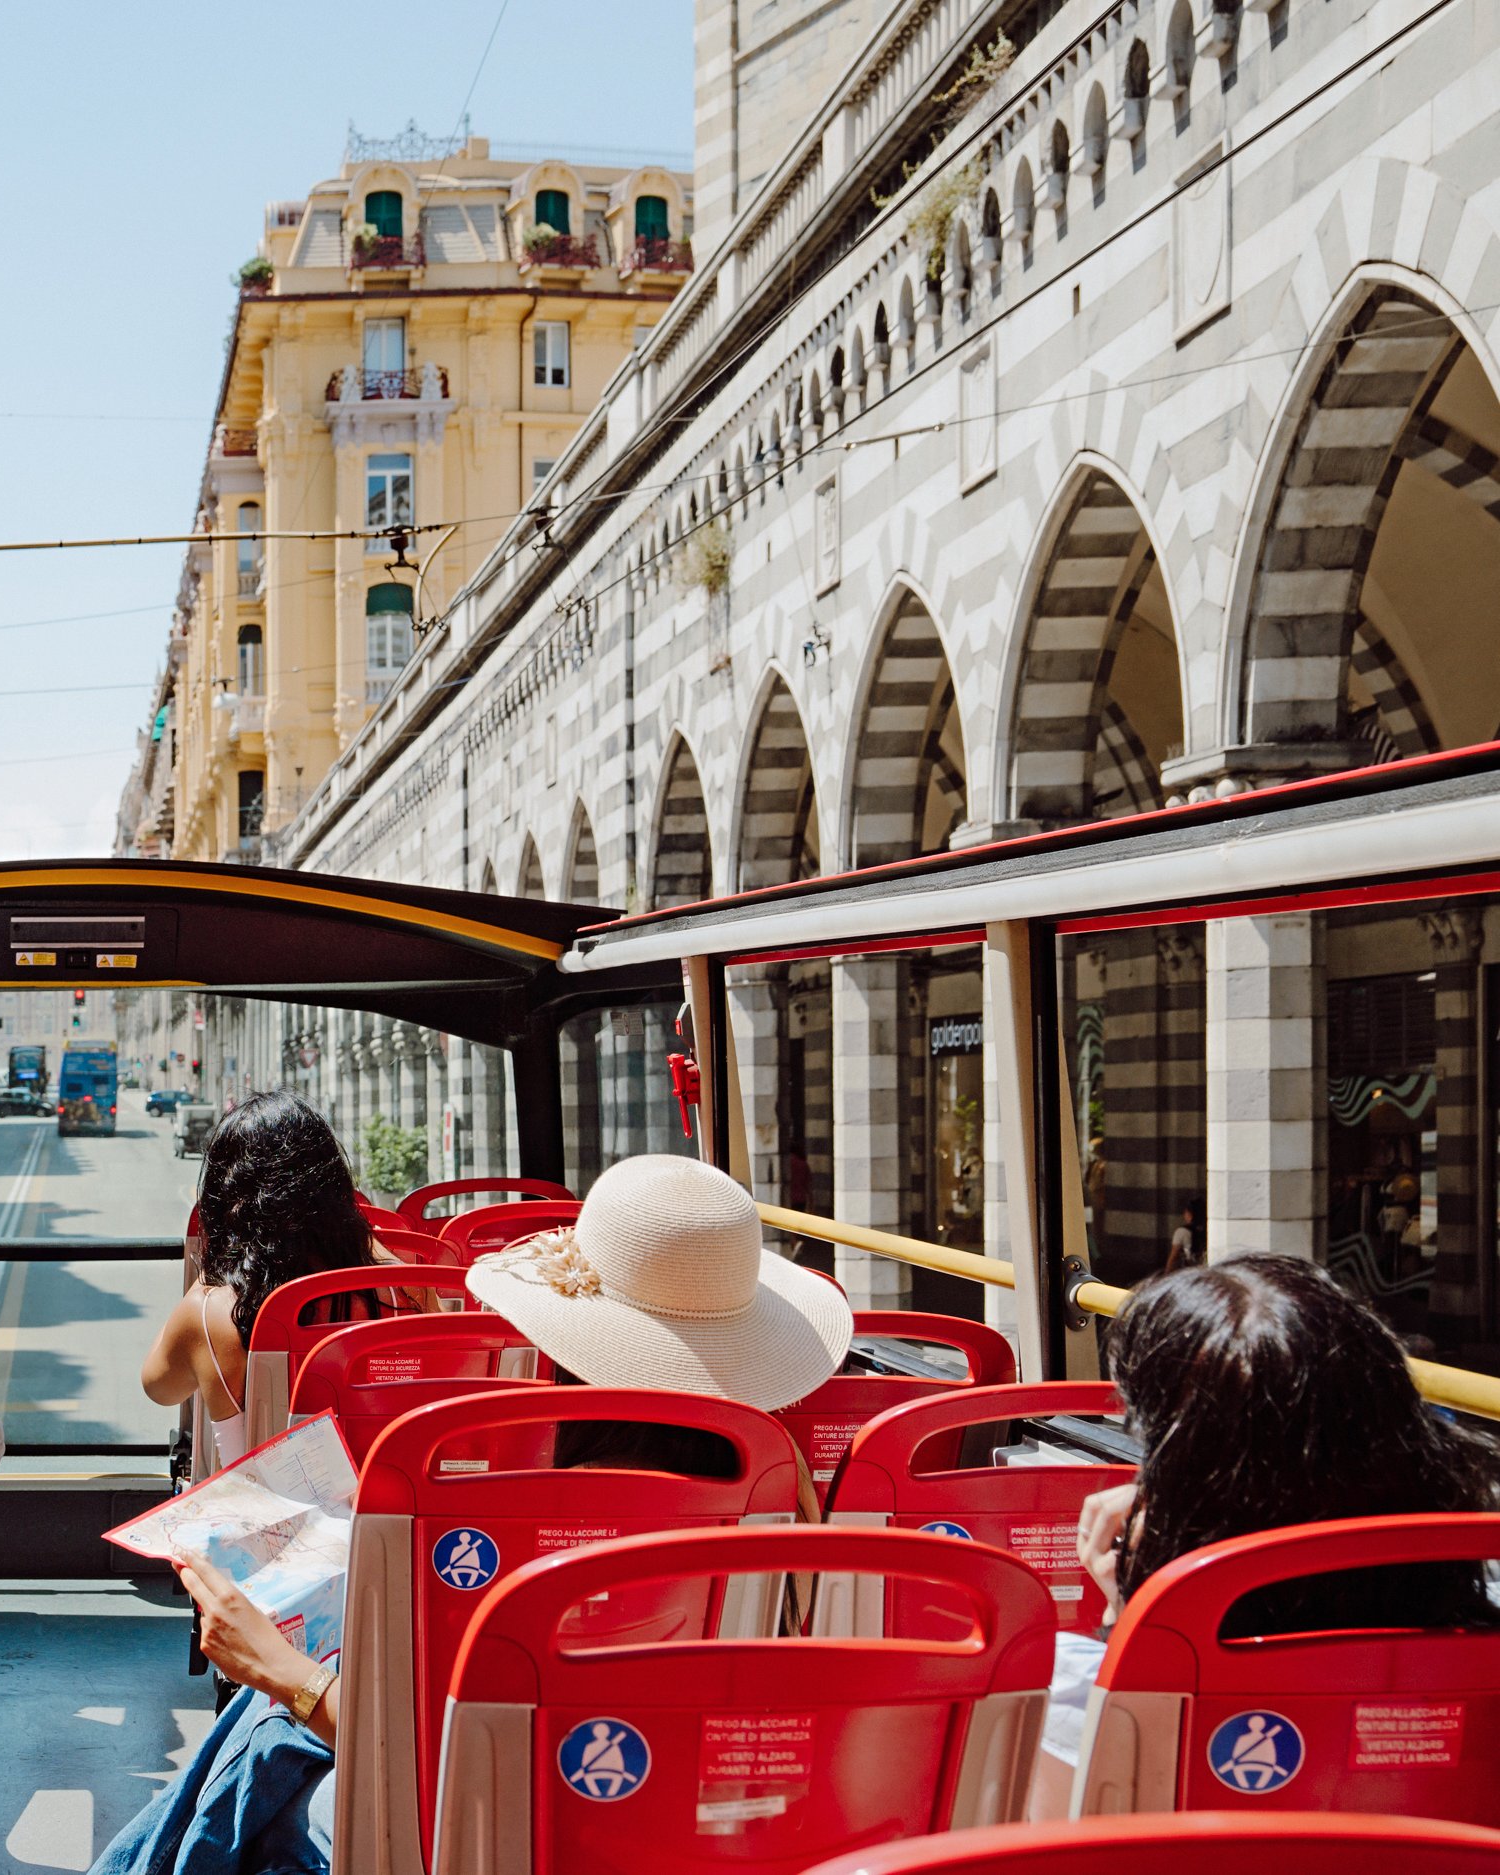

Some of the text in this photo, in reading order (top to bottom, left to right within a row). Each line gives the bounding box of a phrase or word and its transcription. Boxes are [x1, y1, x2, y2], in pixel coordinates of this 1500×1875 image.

[931, 1019, 983, 1055] goldenpoi
[538, 1529, 563, 1537] PREGO
[564, 1529, 607, 1537] ALLACCIARE
[1011, 1526, 1078, 1535] PREGO ALLACCIAR
[538, 1539, 568, 1547] CINTURE
[569, 1539, 577, 1547] DI
[1052, 1536, 1077, 1544] SICURE
[1021, 1551, 1049, 1559] VIETATO
